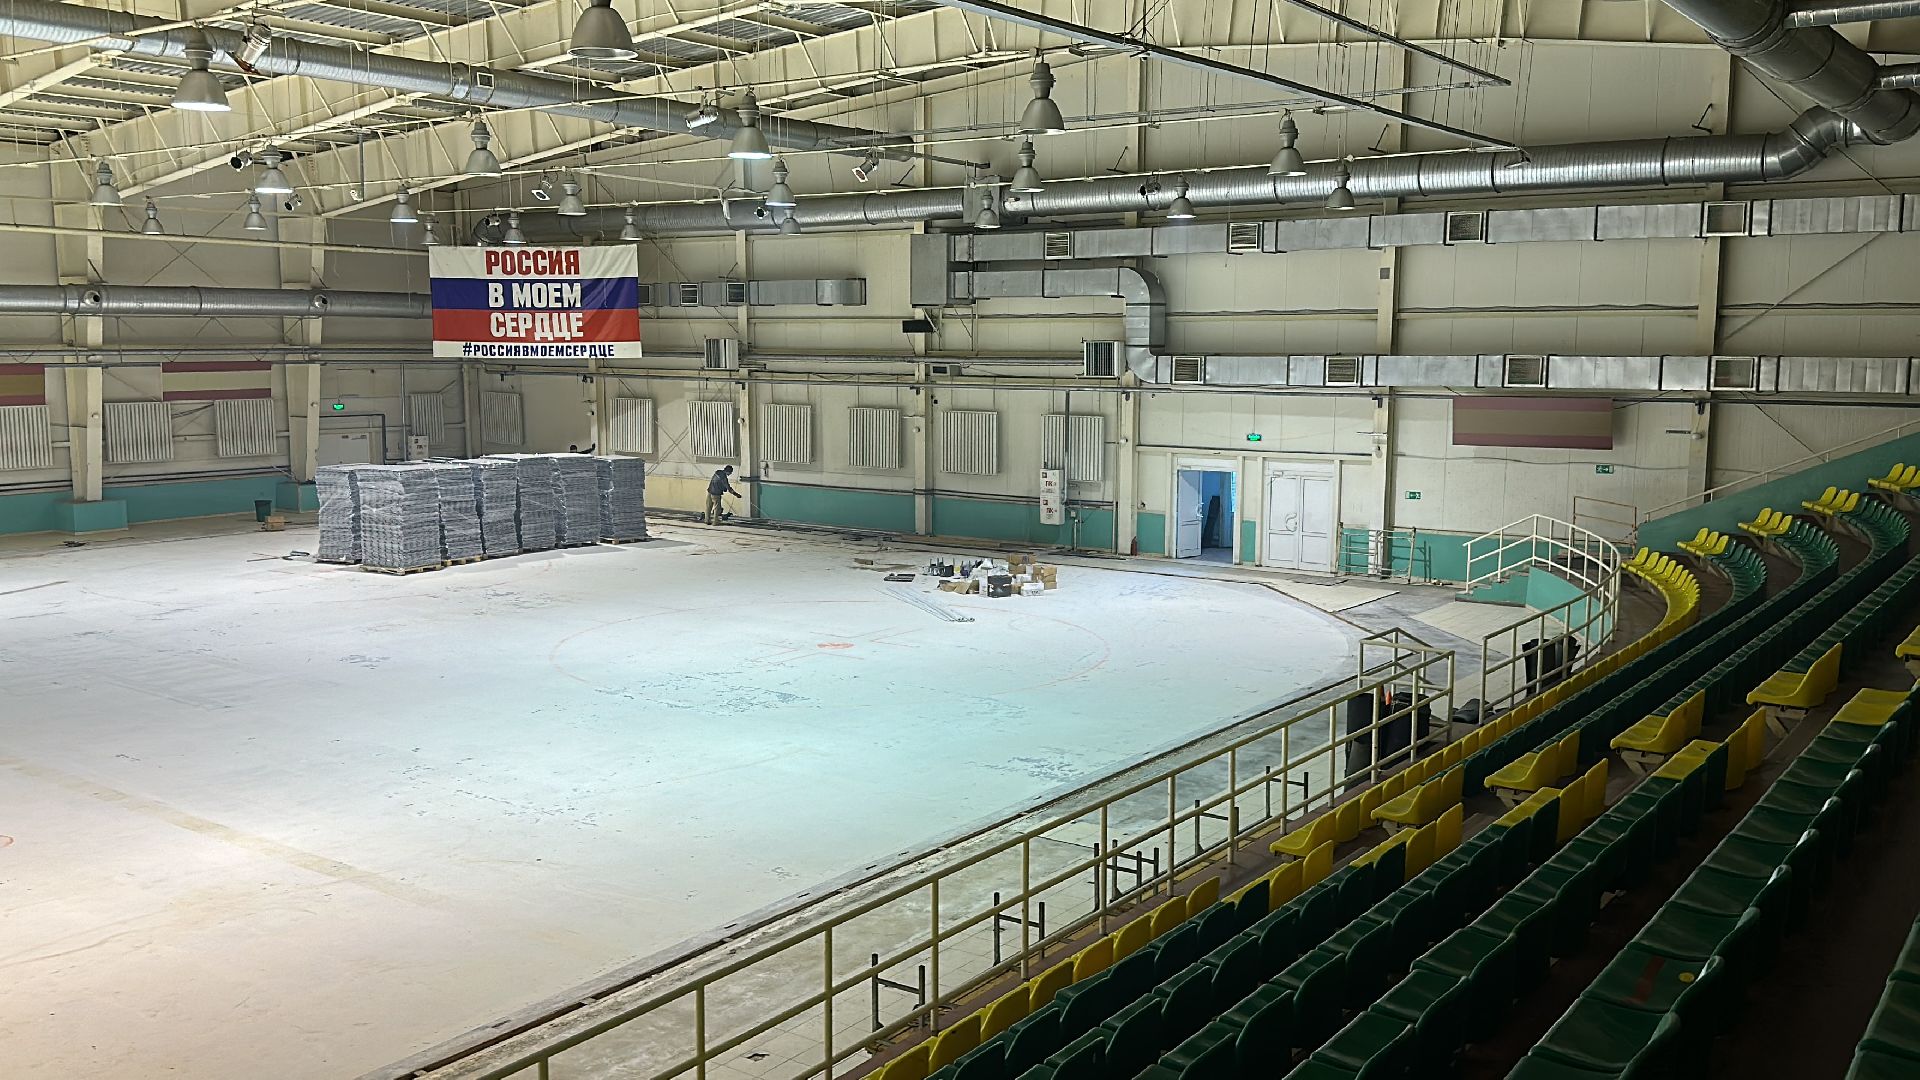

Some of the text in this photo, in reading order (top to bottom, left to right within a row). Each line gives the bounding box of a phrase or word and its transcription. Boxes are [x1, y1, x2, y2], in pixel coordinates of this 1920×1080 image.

[485, 250, 580, 275] РОССИЯ
[488, 282, 582, 308] В МОЕМ
[490, 312, 584, 341] СЕРДЦЕ
[462, 342, 615, 358] #РОССИЯВМОЕМСЕРДЦЕ
